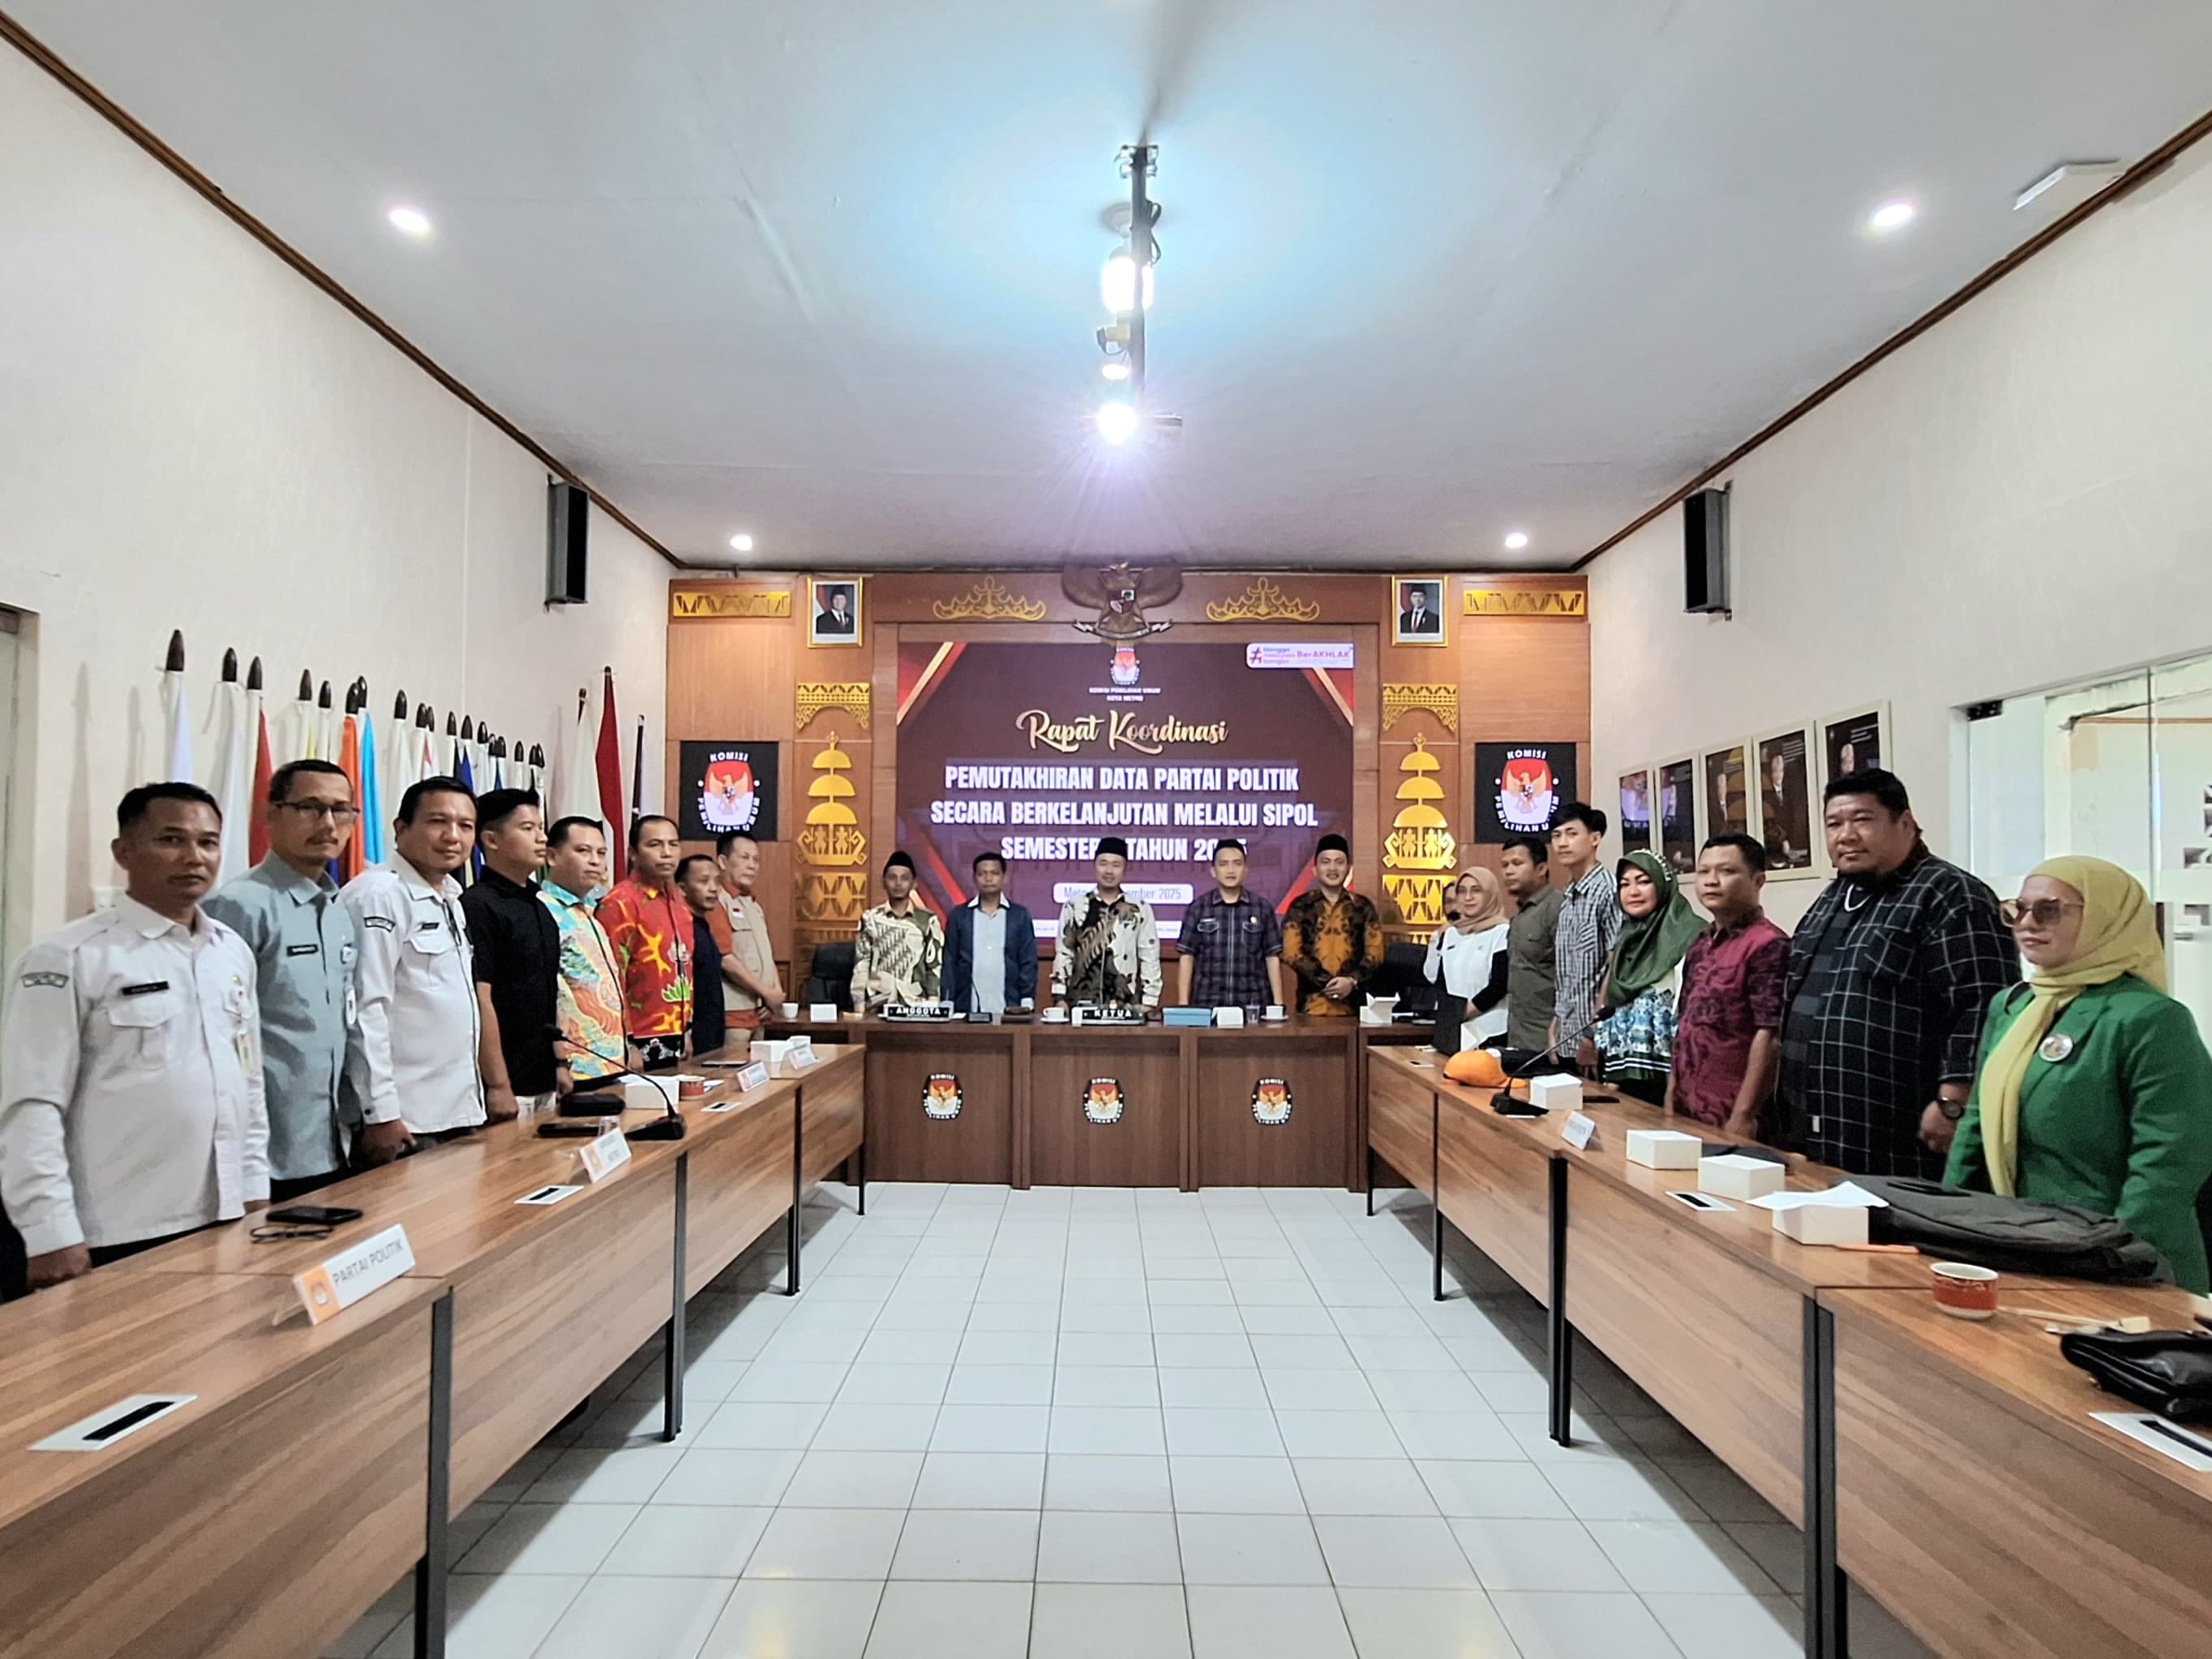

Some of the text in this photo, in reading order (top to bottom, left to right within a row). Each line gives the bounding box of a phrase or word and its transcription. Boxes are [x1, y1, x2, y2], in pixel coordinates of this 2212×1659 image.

[1016, 709, 1228, 754] Rapat Koordinasi
[709, 752, 748, 762] KOMISI
[1507, 749, 1546, 760] KOMISI
[945, 765, 1299, 791] PEMUTAKHIRAN DATA PARTAI POLITIK
[931, 800, 1318, 827] SECARA BERKELANJUTAN MELALUI SIPOL
[1494, 795, 1539, 832] PEMILIHAN
[1125, 838, 1188, 861] TAHUN
[1159, 889, 1181, 899] 2025
[332, 1239, 404, 1285] PARTAI POLITIK
